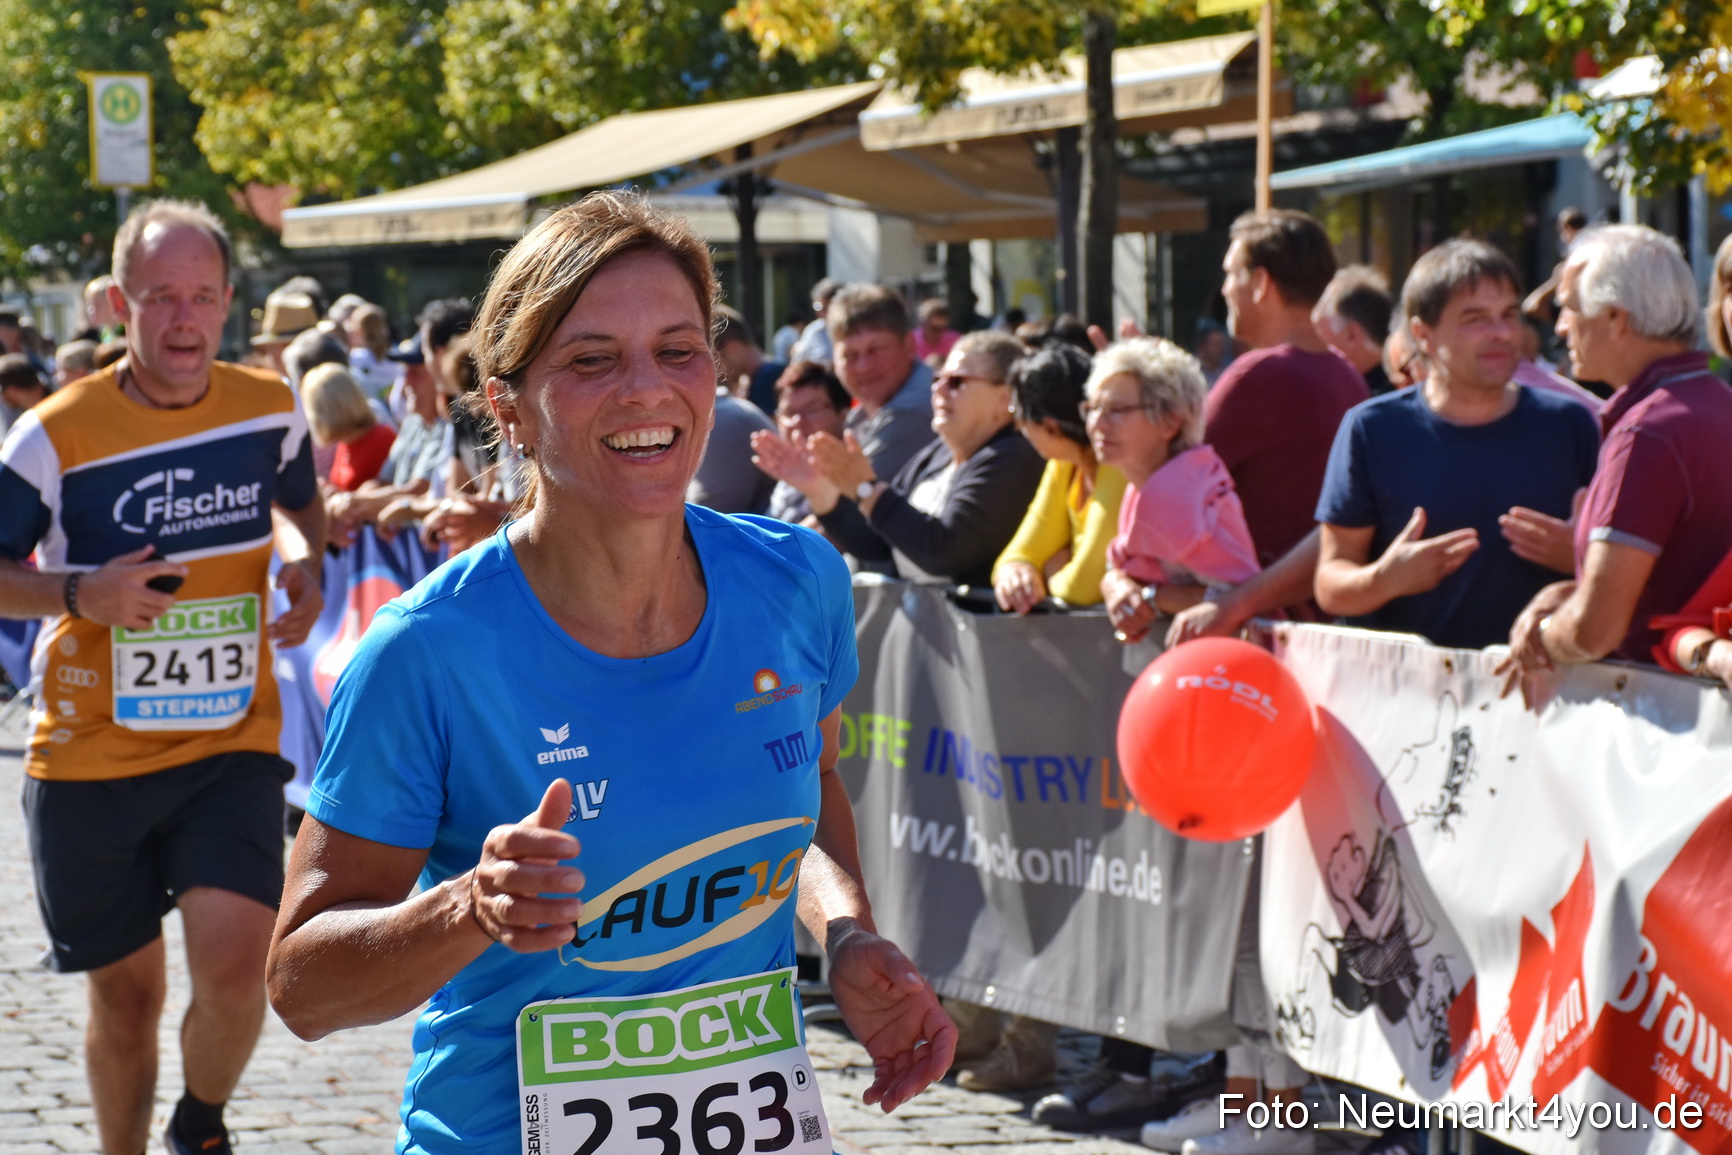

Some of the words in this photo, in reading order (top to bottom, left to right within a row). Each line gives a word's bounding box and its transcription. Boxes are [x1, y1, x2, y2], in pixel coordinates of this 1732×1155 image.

[144, 481, 262, 525] Fischer
[158, 505, 259, 537] AUTOMOBILE
[124, 600, 247, 638] OCK
[132, 643, 243, 687] 2413
[137, 692, 241, 717] STEPHAN
[735, 682, 803, 715] ABENDSCHAU
[536, 744, 590, 766] erima
[763, 730, 810, 774] TUM
[923, 727, 1093, 804] INSTRY
[565, 778, 609, 823] LV
[543, 984, 782, 1073] BOCK
[795, 1070, 806, 1086] D
[1650, 1051, 1691, 1095] Sicher
[542, 1092, 550, 1138] ZEITMESSUNG
[563, 1071, 795, 1155] 2363
